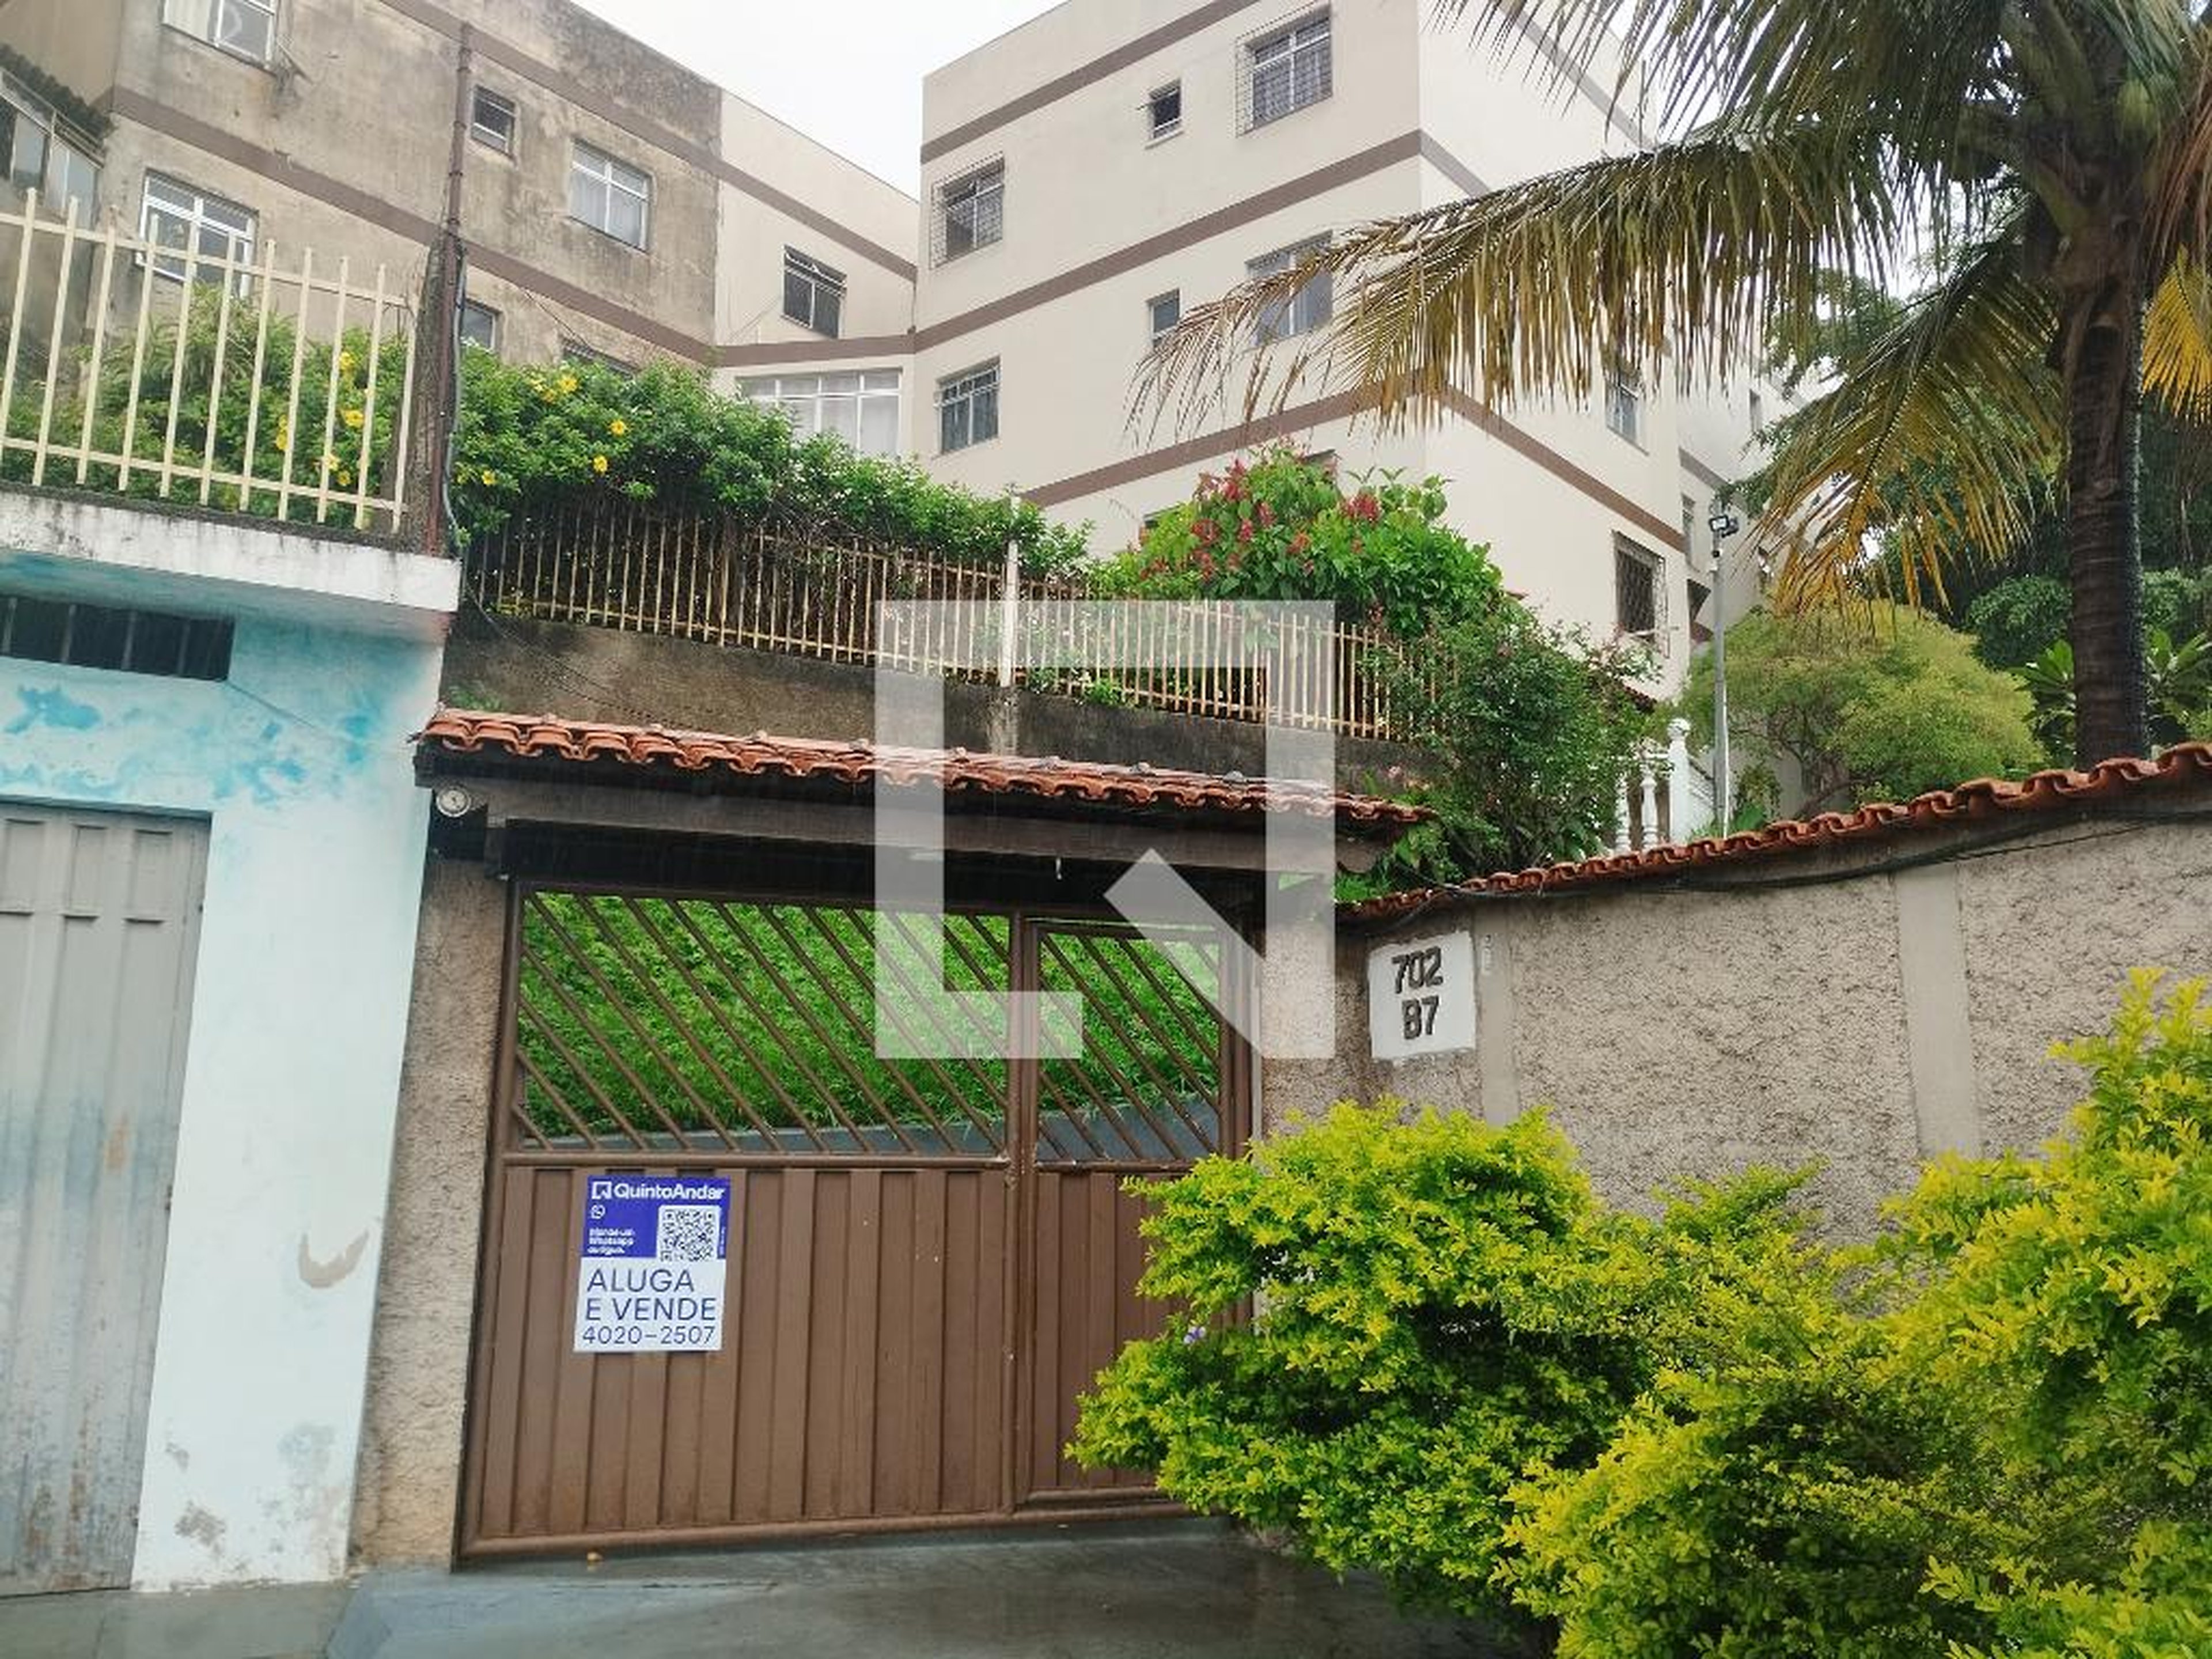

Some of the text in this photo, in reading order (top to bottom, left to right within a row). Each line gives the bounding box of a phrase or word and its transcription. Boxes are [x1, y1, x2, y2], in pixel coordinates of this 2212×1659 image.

[1392, 946, 1444, 994] 702
[613, 1183, 725, 1200] QuintoAndar
[586, 1268, 695, 1292] ALUGA
[585, 1297, 717, 1321] E VENDE
[582, 1325, 715, 1344] 4020-2507
